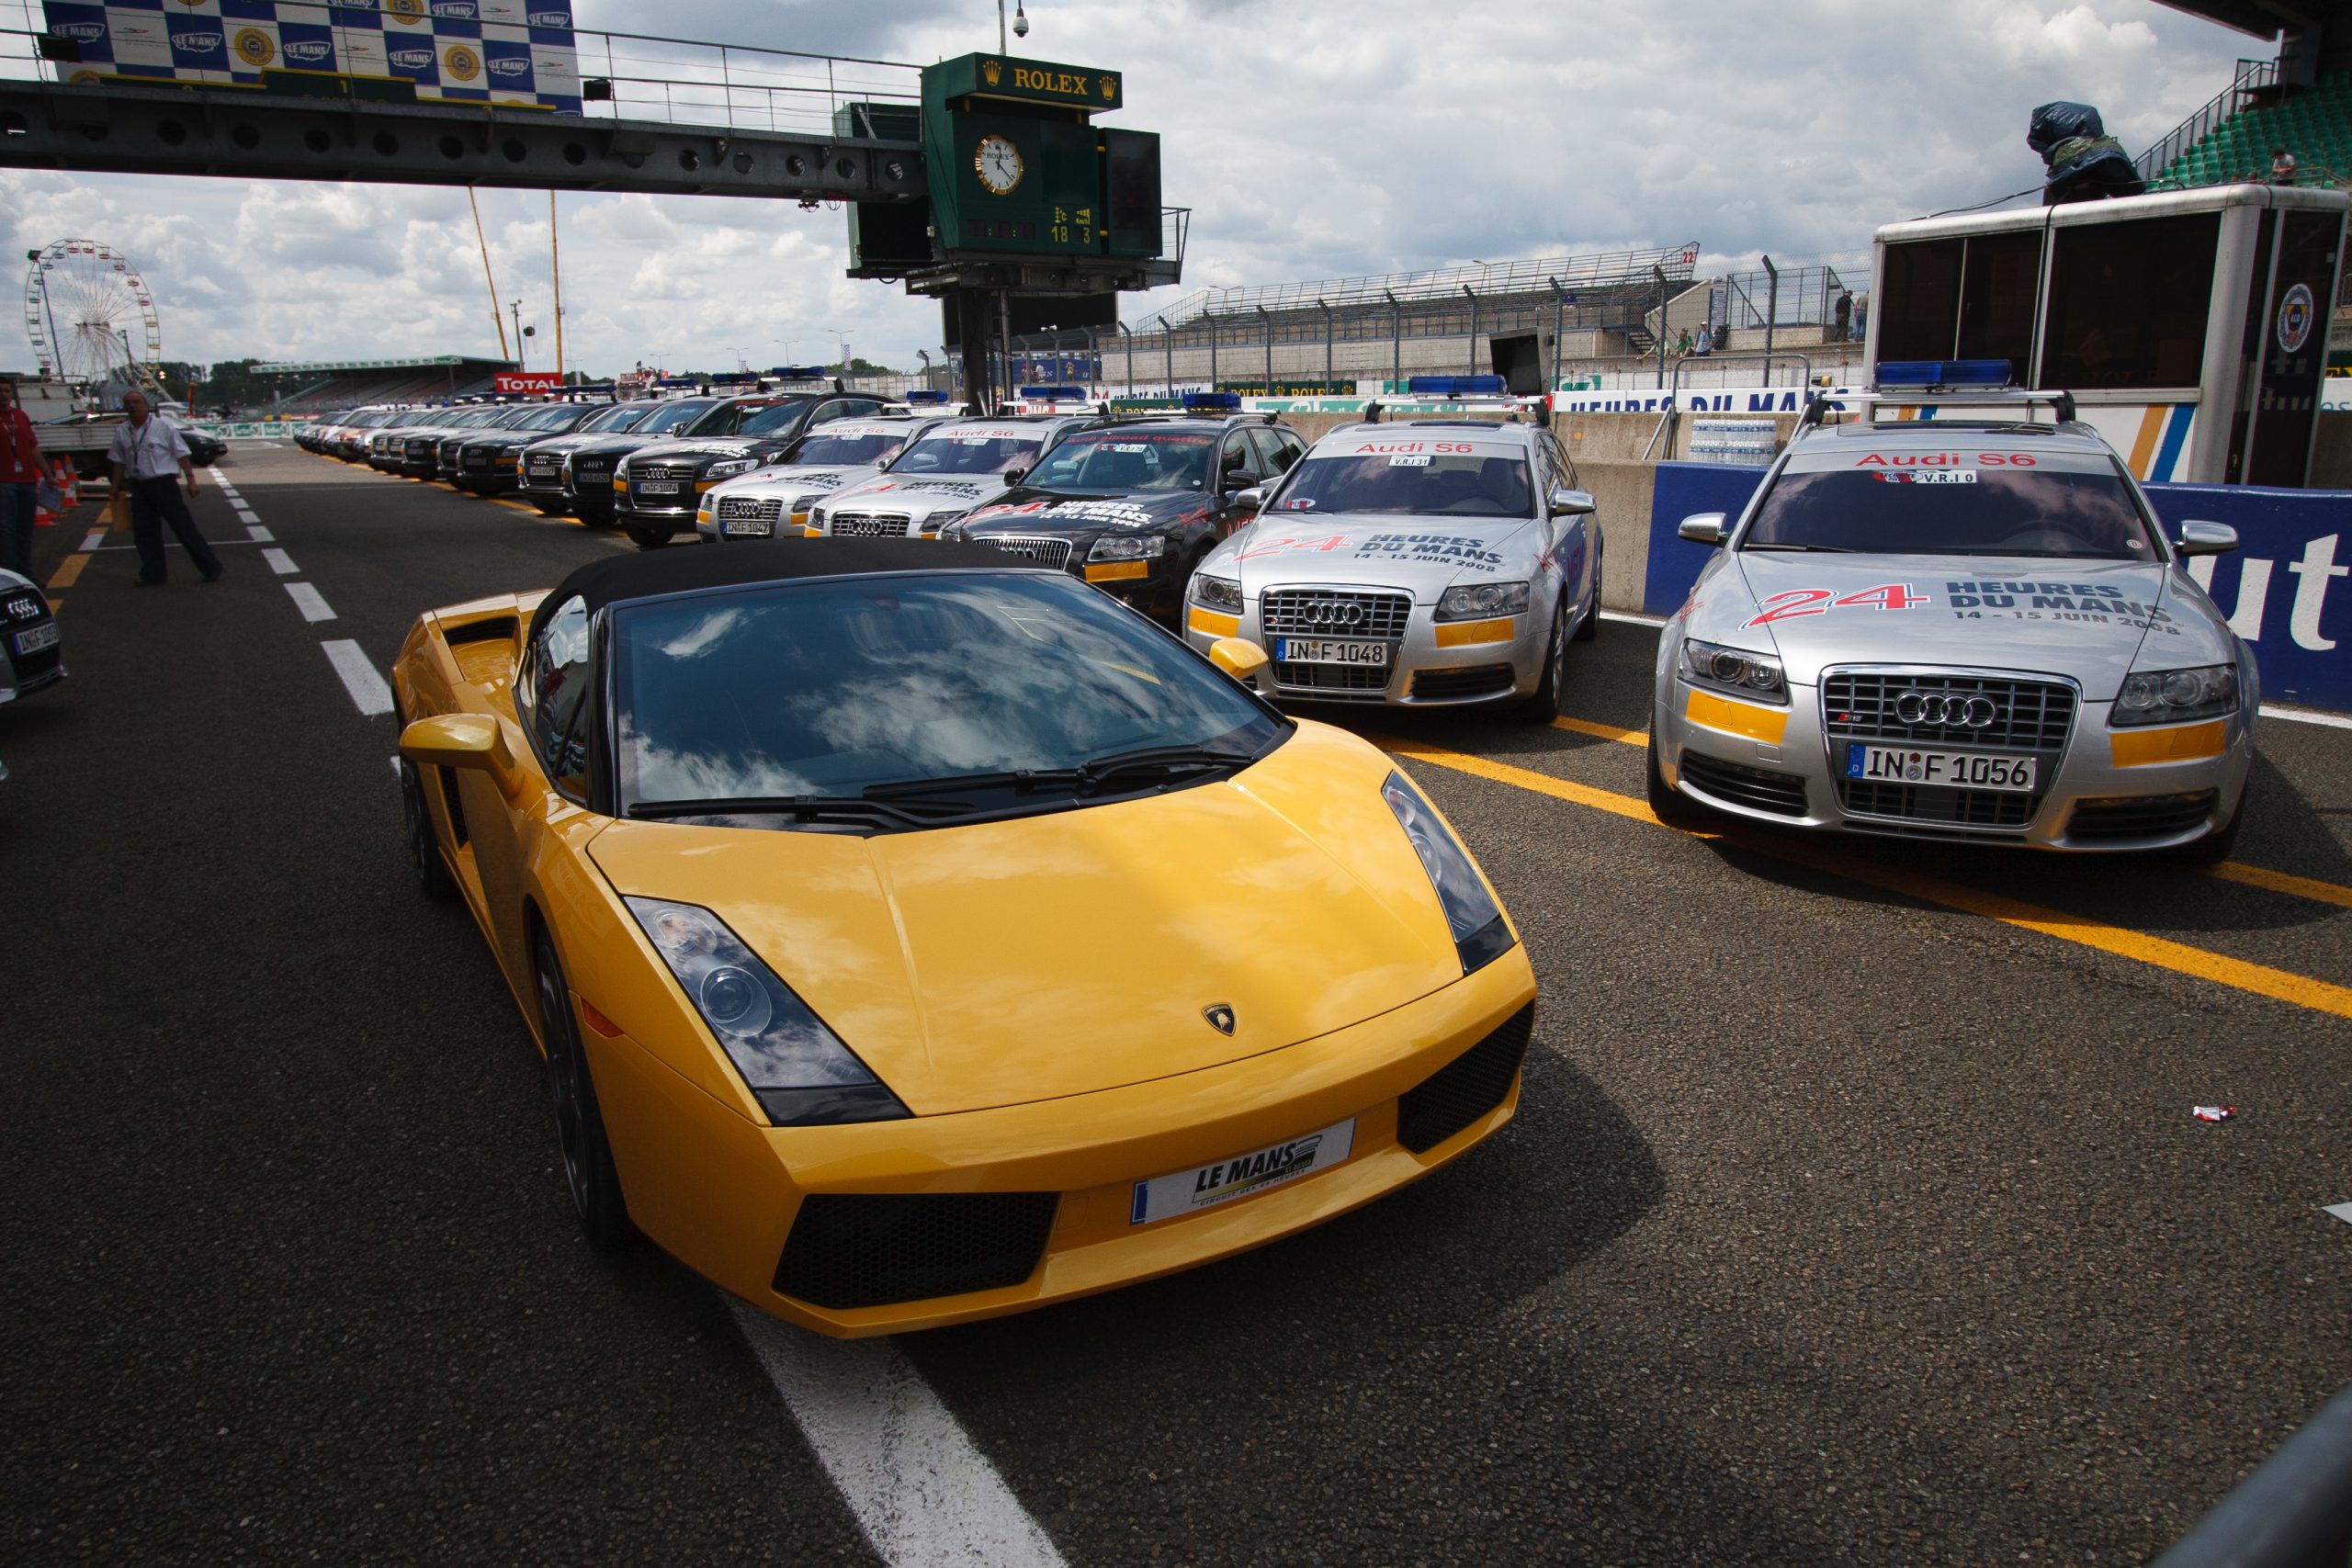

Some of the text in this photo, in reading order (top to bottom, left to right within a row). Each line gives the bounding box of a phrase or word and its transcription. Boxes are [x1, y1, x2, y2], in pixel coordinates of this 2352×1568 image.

[447, 5, 471, 16] MANS
[543, 15, 566, 26] MANS
[70, 26, 99, 39] MANS
[188, 36, 216, 47] MANS
[300, 45, 326, 56] MANS
[405, 53, 430, 65] MANS
[501, 62, 526, 73] MANS
[1014, 68, 1088, 96] ROLEX
[1051, 226, 1068, 243] 18
[1083, 227, 1090, 243] 3
[1682, 251, 1694, 264] 22
[497, 378, 561, 390] TOTAL
[1152, 435, 1208, 445] quattro
[1354, 443, 1474, 454] Audi S6
[1855, 453, 2037, 467] Audi S6
[1057, 501, 1145, 512] HEURES
[1082, 507, 1154, 522] MANS
[727, 523, 738, 533] IN
[748, 523, 768, 534] 1047
[1110, 517, 1141, 528] 2008
[1369, 534, 1485, 548] HEURES
[1233, 535, 1354, 562] 24
[1360, 542, 1503, 565] DU MANS
[1413, 555, 1451, 564] JUIN
[1456, 559, 1496, 572] 2008
[1946, 581, 2124, 598] HEURES
[1736, 582, 1931, 632] 24
[1949, 595, 2173, 624] DU MANS
[1954, 611, 1982, 619] 14
[2013, 611, 2042, 619] 15
[2052, 613, 2109, 624] JUIN
[2117, 617, 2181, 636] 2008
[1288, 641, 1309, 660] IN
[1321, 643, 1333, 660] F
[1336, 643, 1383, 663] 1048
[1867, 750, 1905, 778] IN
[1924, 754, 1945, 781] F
[1951, 756, 2029, 786] 1056
[1194, 1142, 1297, 1193] LE MANS
